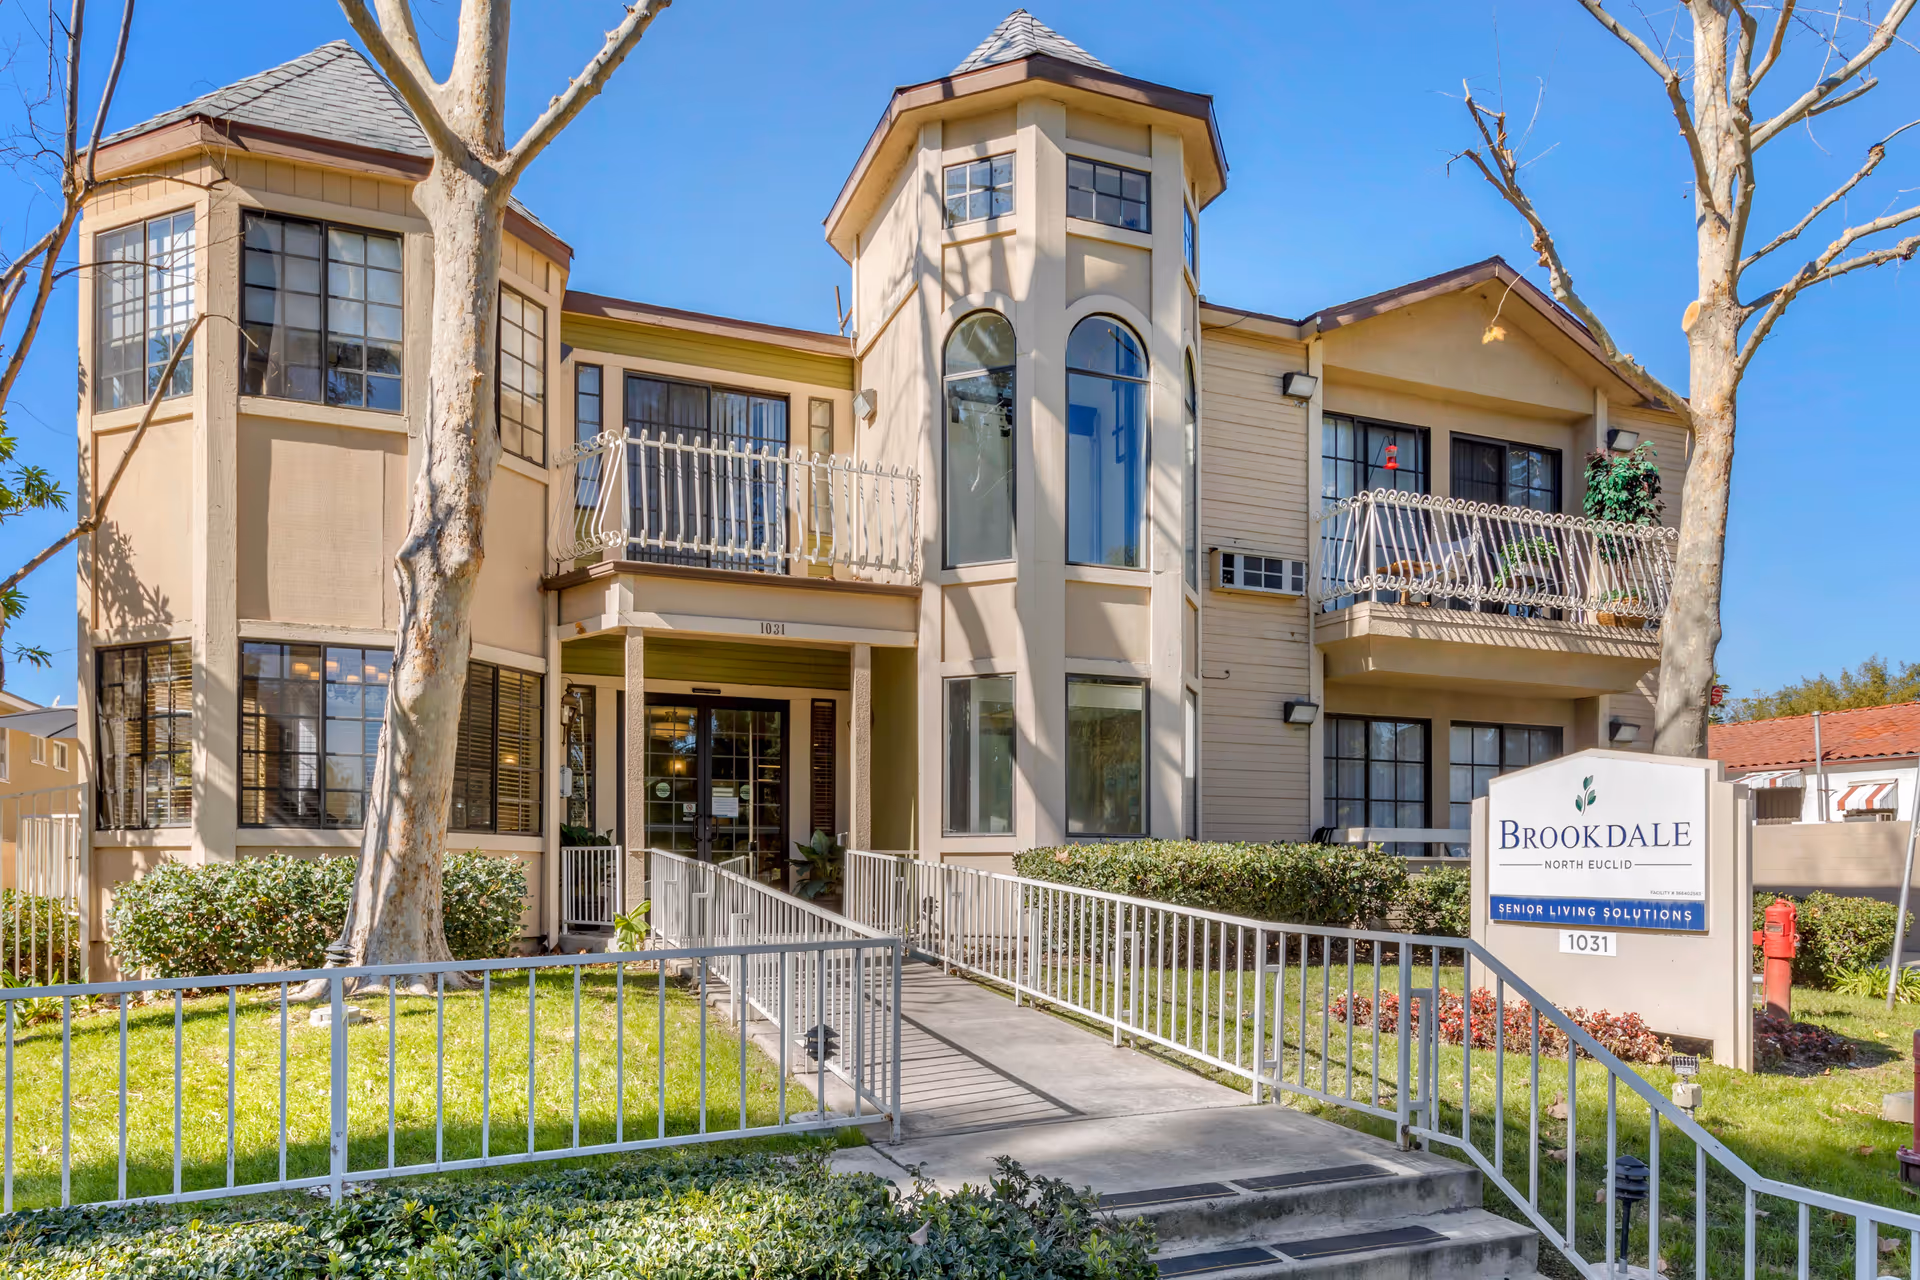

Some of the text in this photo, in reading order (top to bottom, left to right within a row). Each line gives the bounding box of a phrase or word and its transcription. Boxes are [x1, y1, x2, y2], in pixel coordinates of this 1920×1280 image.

[760, 622, 785, 635] 1031
[1498, 819, 1692, 850] BROOKDALE
[1544, 859, 1632, 870] NORTH EUCLID
[1498, 903, 1692, 921] SENIOR LIVING SOLUTIONS
[1568, 933, 1608, 953] 1031
